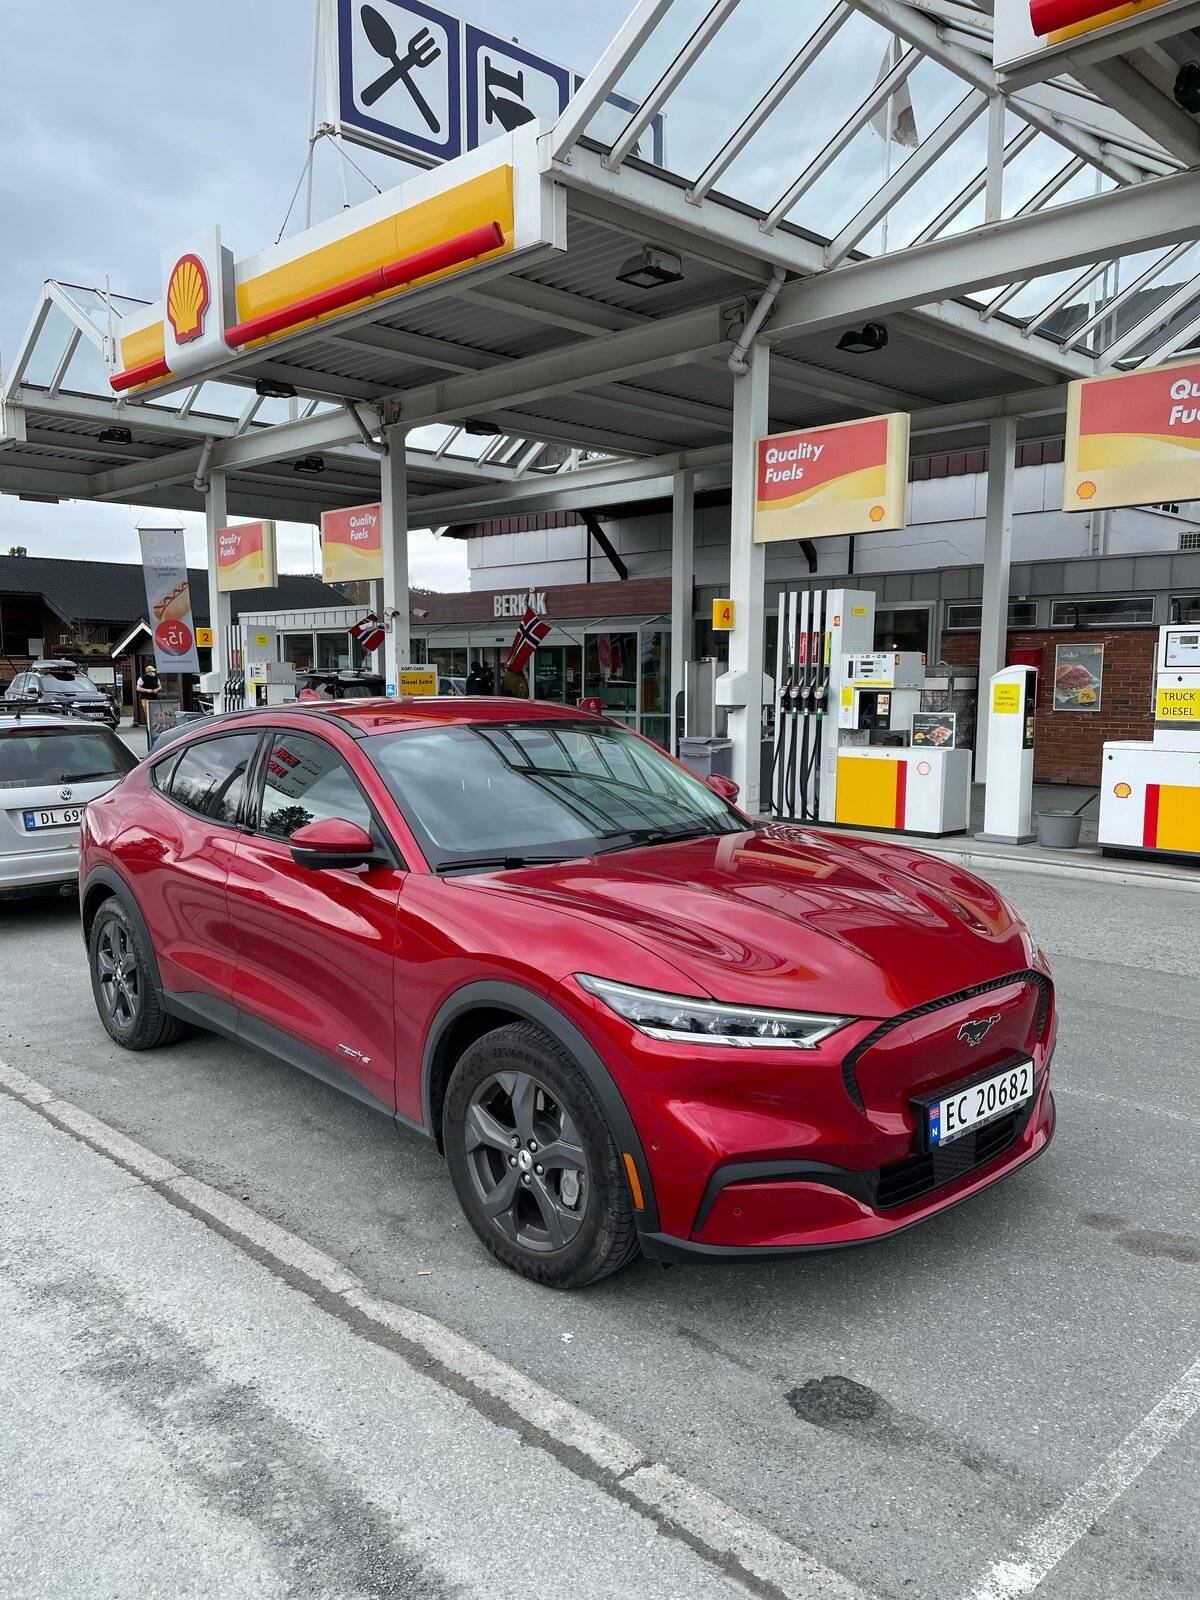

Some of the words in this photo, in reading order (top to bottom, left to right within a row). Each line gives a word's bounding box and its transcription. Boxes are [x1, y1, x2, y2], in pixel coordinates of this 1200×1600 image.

[765, 443, 824, 464] Quality
[765, 464, 804, 483] Fuels
[350, 513, 377, 527] Quality
[220, 534, 241, 545] Quality
[350, 528, 369, 540] Fuels
[220, 546, 235, 556] Fuels
[494, 586, 548, 617] BERKÅK
[723, 607, 731, 622] 4
[202, 633, 209, 642] 2
[1164, 692, 1196, 701] TRUCK
[1162, 707, 1194, 716] DIESEL
[41, 812, 58, 825] DL
[64, 809, 84, 823] 69
[946, 1095, 968, 1132] EC
[977, 1069, 1027, 1117] 20682
[932, 1127, 938, 1138] N
